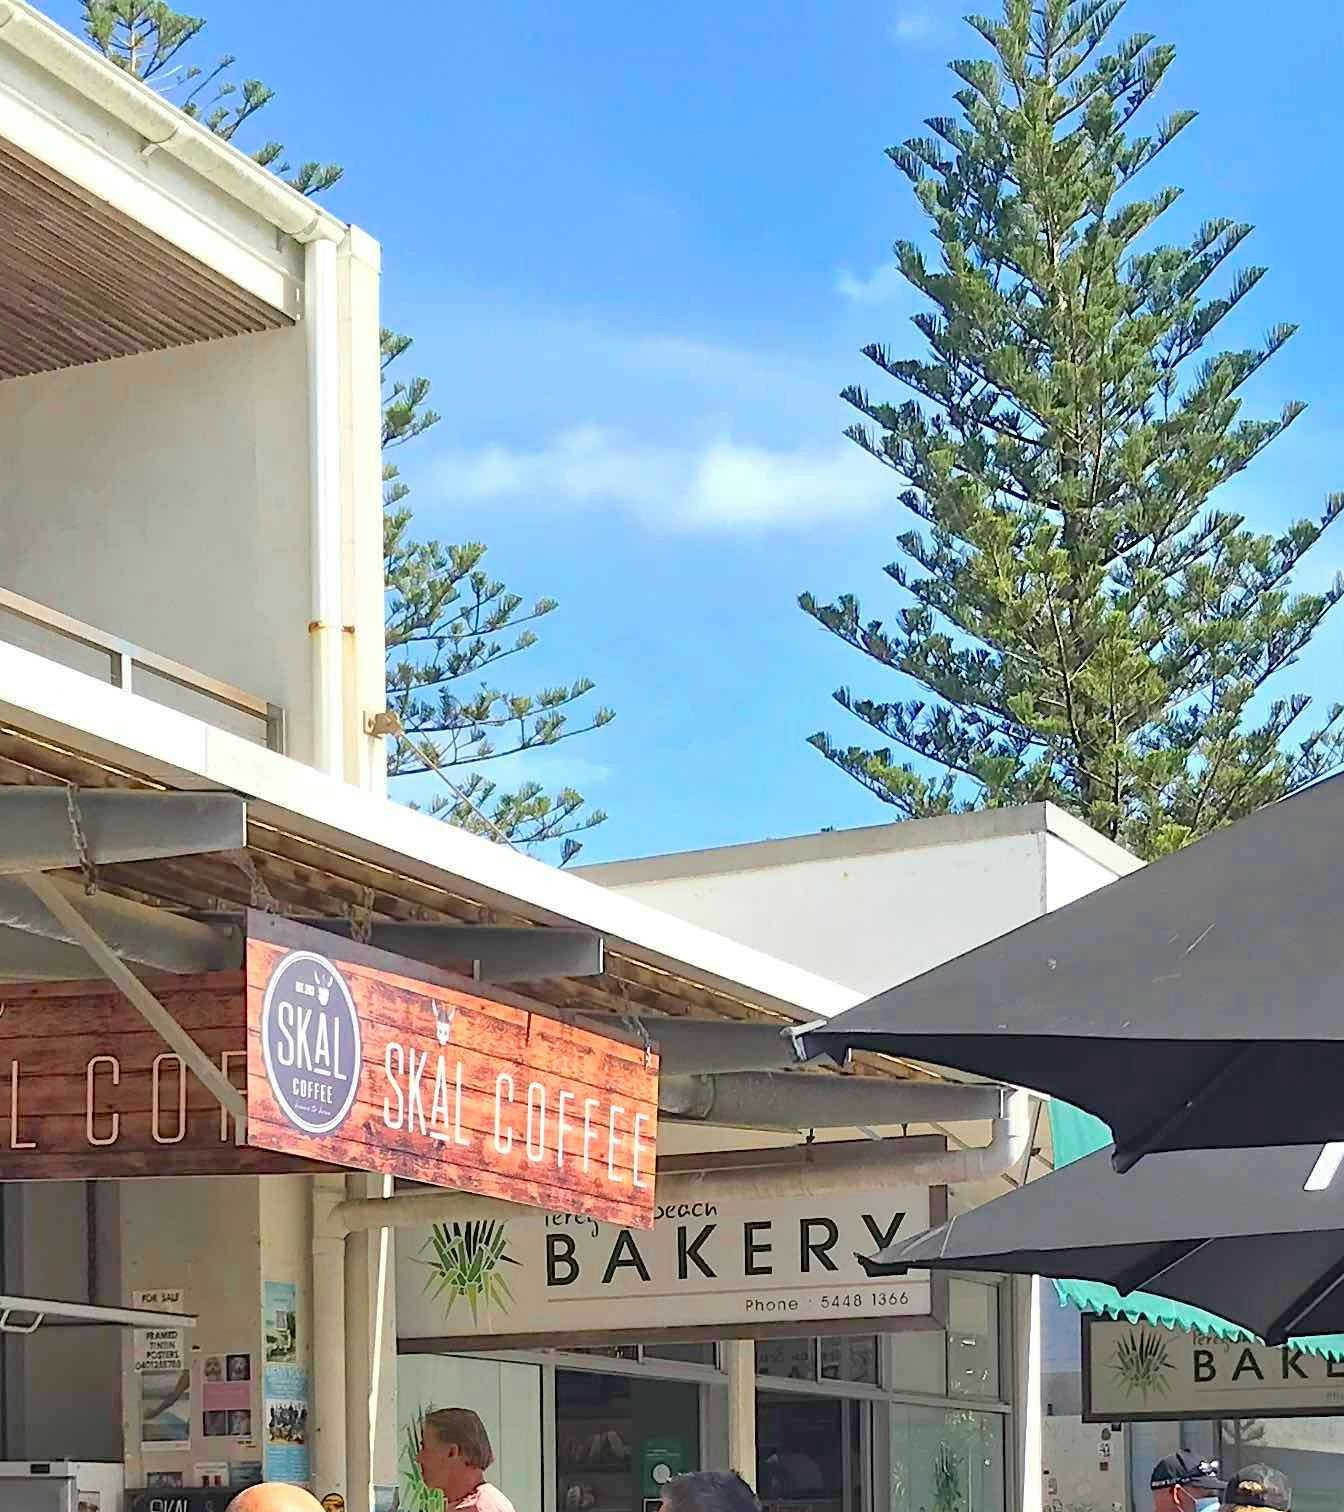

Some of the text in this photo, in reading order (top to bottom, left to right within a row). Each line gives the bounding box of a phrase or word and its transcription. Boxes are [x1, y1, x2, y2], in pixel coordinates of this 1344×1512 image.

[292, 1077, 333, 1104] COFFEE
[494, 1072, 650, 1188] COFFEE
[545, 1212, 907, 1287] BAKERY
[745, 1291, 909, 1312] Phone 5448 1366
